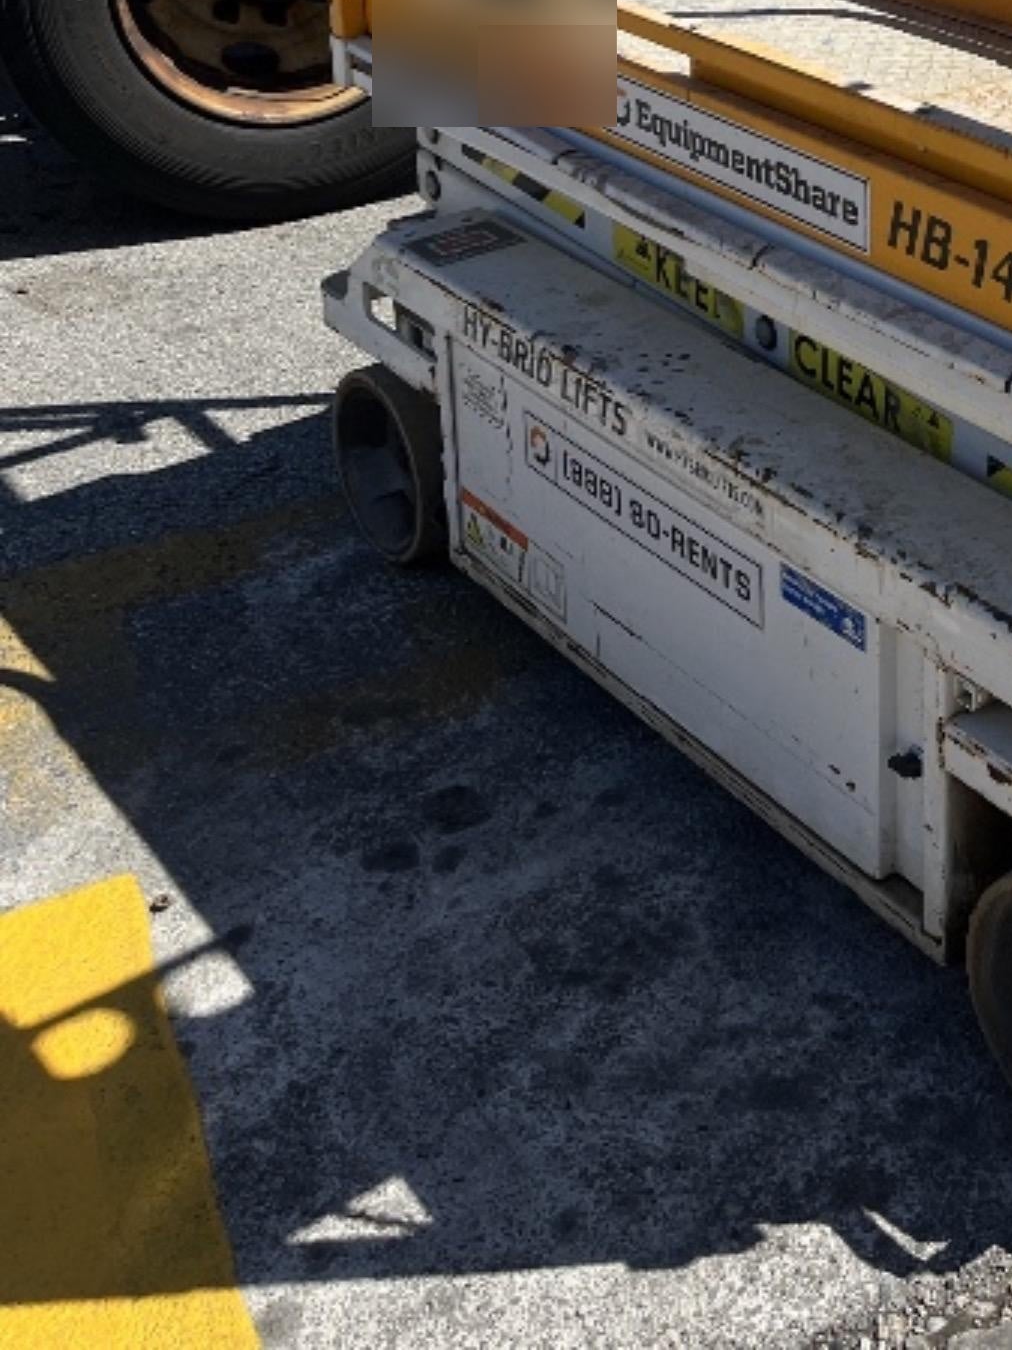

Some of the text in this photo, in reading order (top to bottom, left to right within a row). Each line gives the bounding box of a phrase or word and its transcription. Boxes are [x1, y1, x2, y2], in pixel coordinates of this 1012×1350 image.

[635, 99, 859, 226] EquipmentShare
[560, 368, 627, 436] LIFTS
[792, 334, 901, 433] CLEAR
[562, 450, 622, 517] (888)
[629, 499, 752, 602] 80-RENTS
